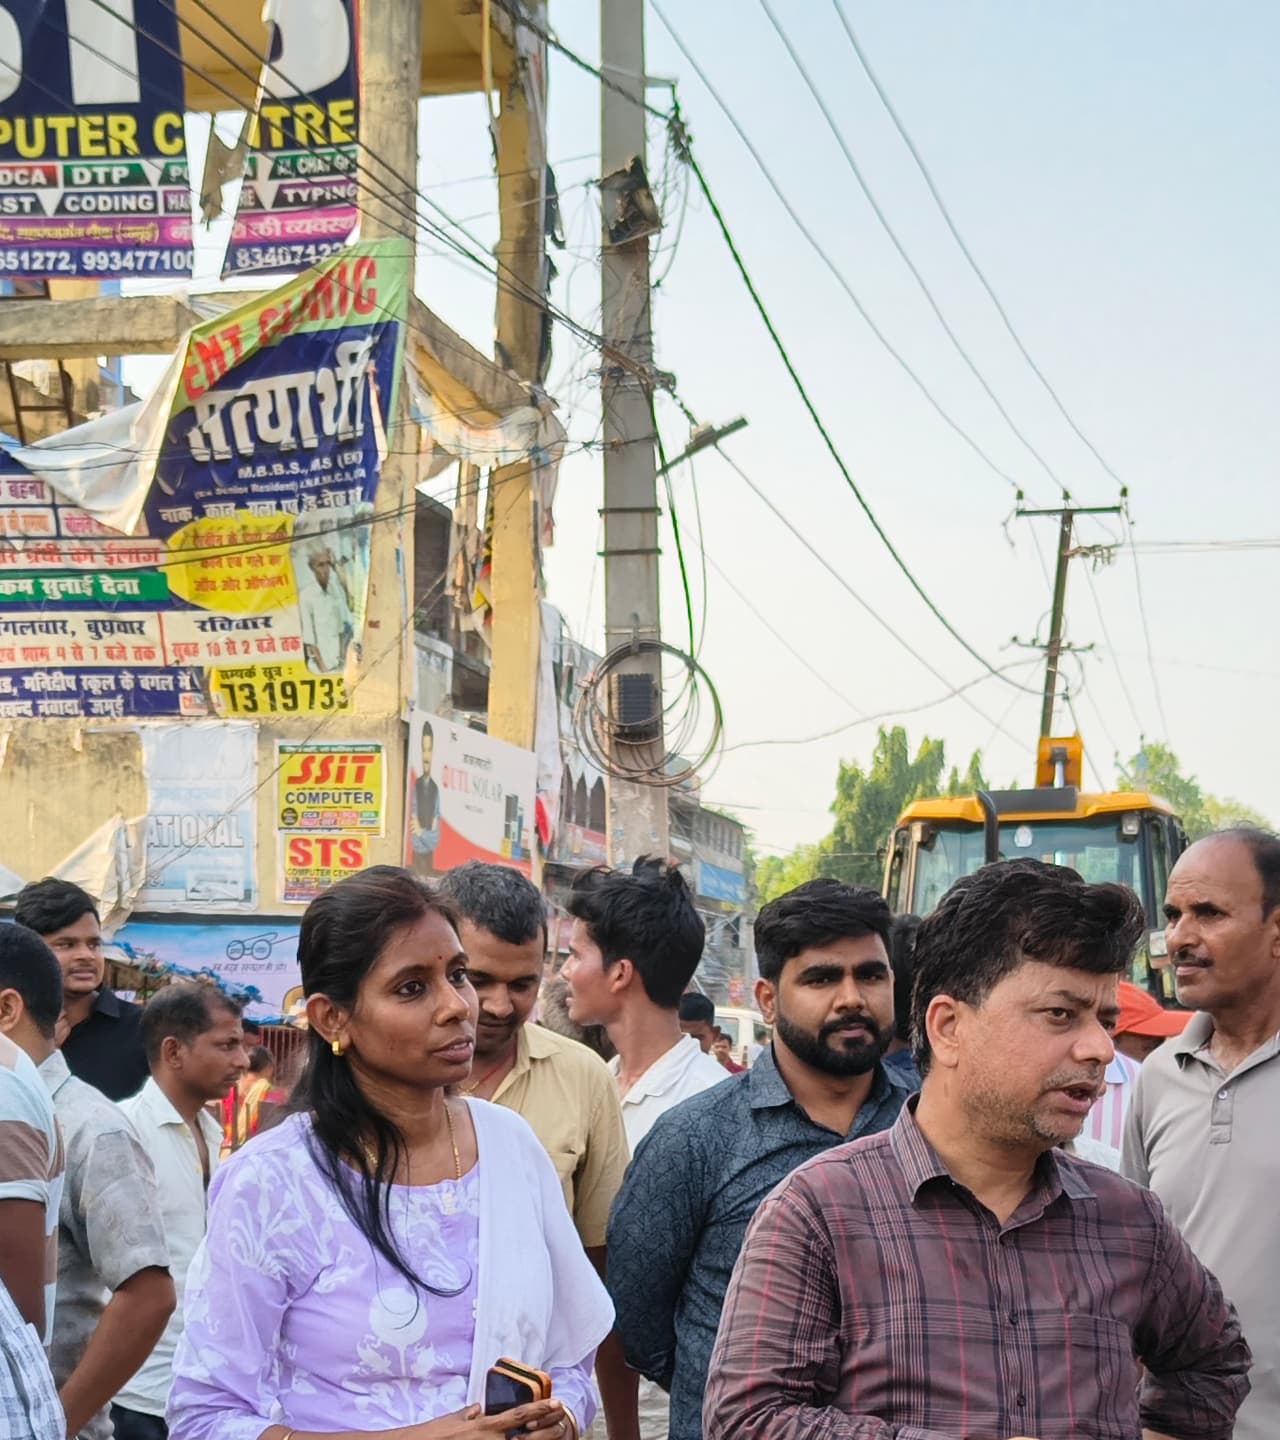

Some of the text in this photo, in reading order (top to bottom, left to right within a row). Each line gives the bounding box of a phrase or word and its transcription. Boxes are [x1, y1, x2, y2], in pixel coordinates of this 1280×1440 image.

[72, 166, 130, 185] DTP
[64, 194, 154, 213] CODING
[282, 185, 358, 203] TYPING
[6, 480, 45, 500] बहना
[99, 574, 140, 596] देना
[132, 646, 156, 661] तक
[119, 671, 135, 690] के
[138, 674, 174, 691] बगल
[285, 791, 374, 805] COMPUTER
[146, 814, 244, 848] ATIONAL
[289, 838, 363, 868] STS
